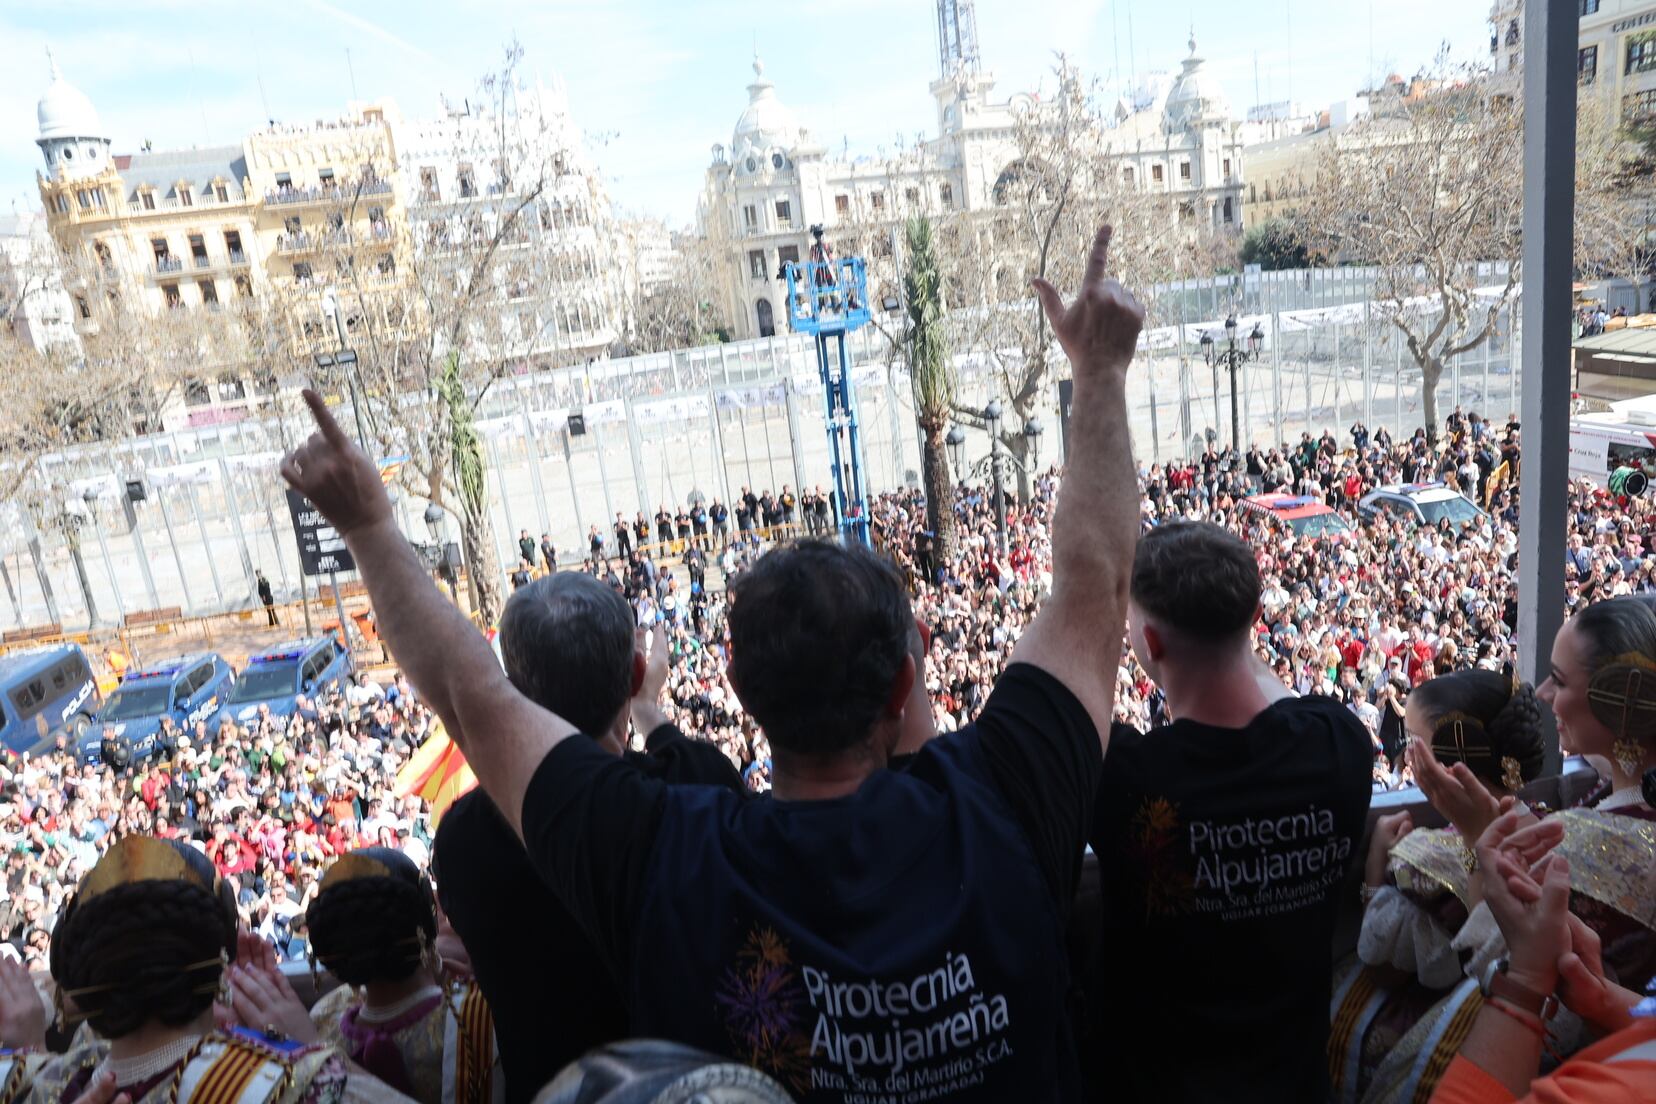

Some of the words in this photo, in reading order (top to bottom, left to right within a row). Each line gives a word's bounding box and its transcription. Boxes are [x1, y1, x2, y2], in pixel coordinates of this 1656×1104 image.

[1189, 803, 1334, 855] Pirotecnia
[1193, 835, 1352, 896] Alpujarreña
[1254, 889, 1273, 905] del
[802, 951, 976, 1019] Pirotecnia
[809, 991, 1010, 1076] Alpujarreña
[811, 1067, 848, 1091] Ntra.
[851, 1072, 882, 1093] Sra.
[885, 1069, 910, 1092] del
[913, 1057, 973, 1088] Martirio
[975, 1037, 1014, 1067] S.C.A.
